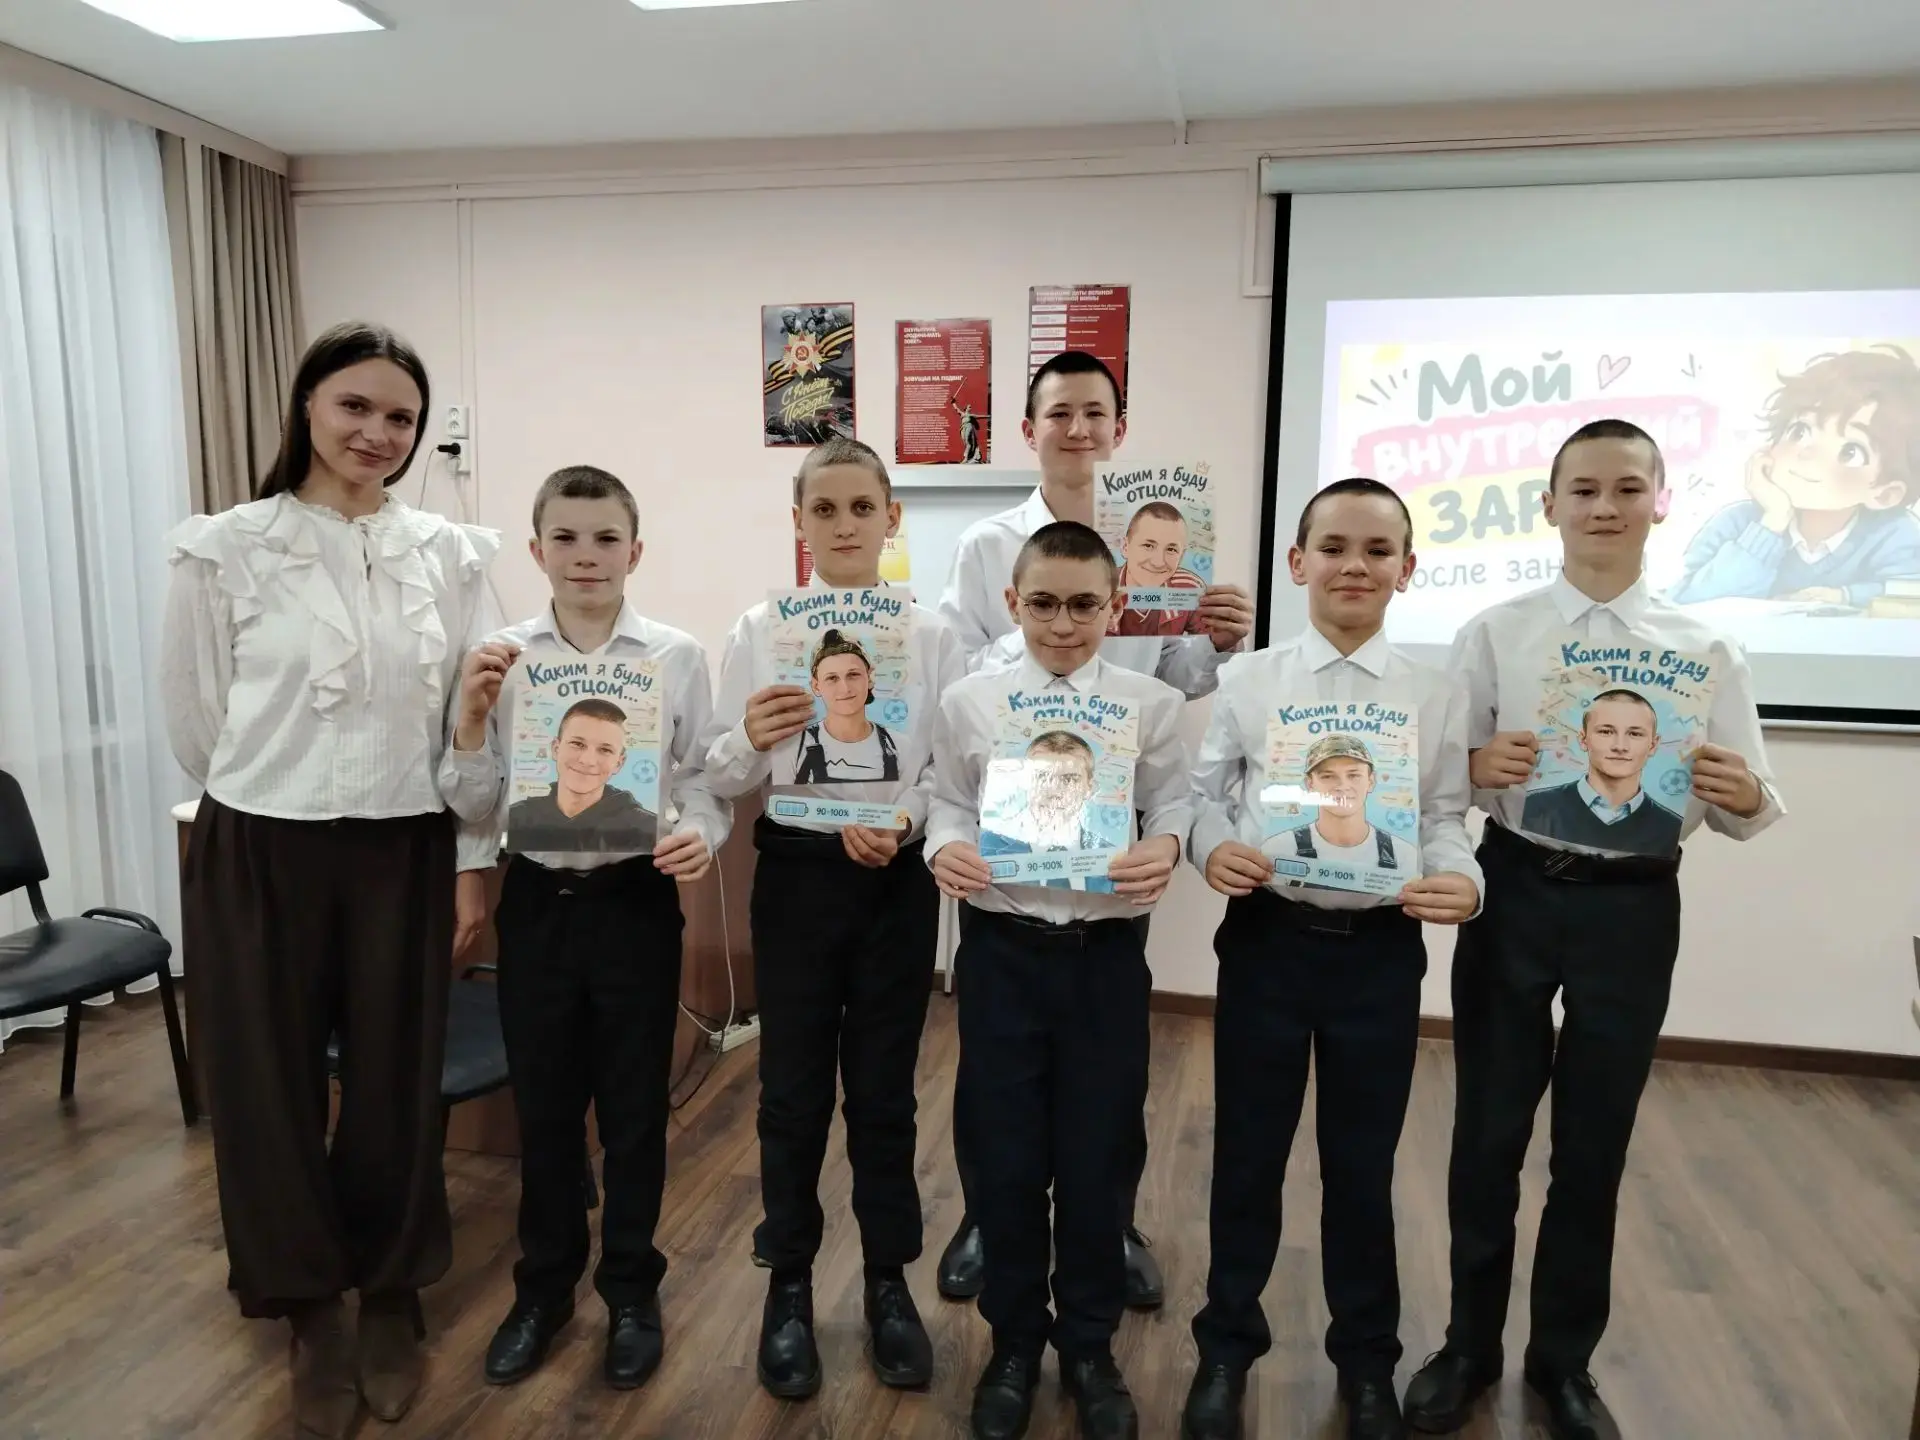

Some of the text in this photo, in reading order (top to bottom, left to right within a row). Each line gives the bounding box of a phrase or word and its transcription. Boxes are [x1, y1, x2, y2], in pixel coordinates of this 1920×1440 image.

[1417, 350, 1573, 421] Мой
[1102, 466, 1208, 495] Каким я буду
[1429, 479, 1553, 543] ЗАР
[1412, 562, 1487, 589] осле
[777, 590, 902, 620] Каким я буду
[1132, 594, 1162, 602] 90-100%
[1561, 641, 1710, 682] Каким я буду
[525, 662, 653, 692] Каким я буду
[1007, 690, 1128, 720] Каким я буду
[1278, 703, 1409, 726] Каким я буду
[816, 807, 850, 817] 90-100%
[1027, 860, 1063, 872] 90-100%
[1318, 868, 1356, 880] 90-100%
